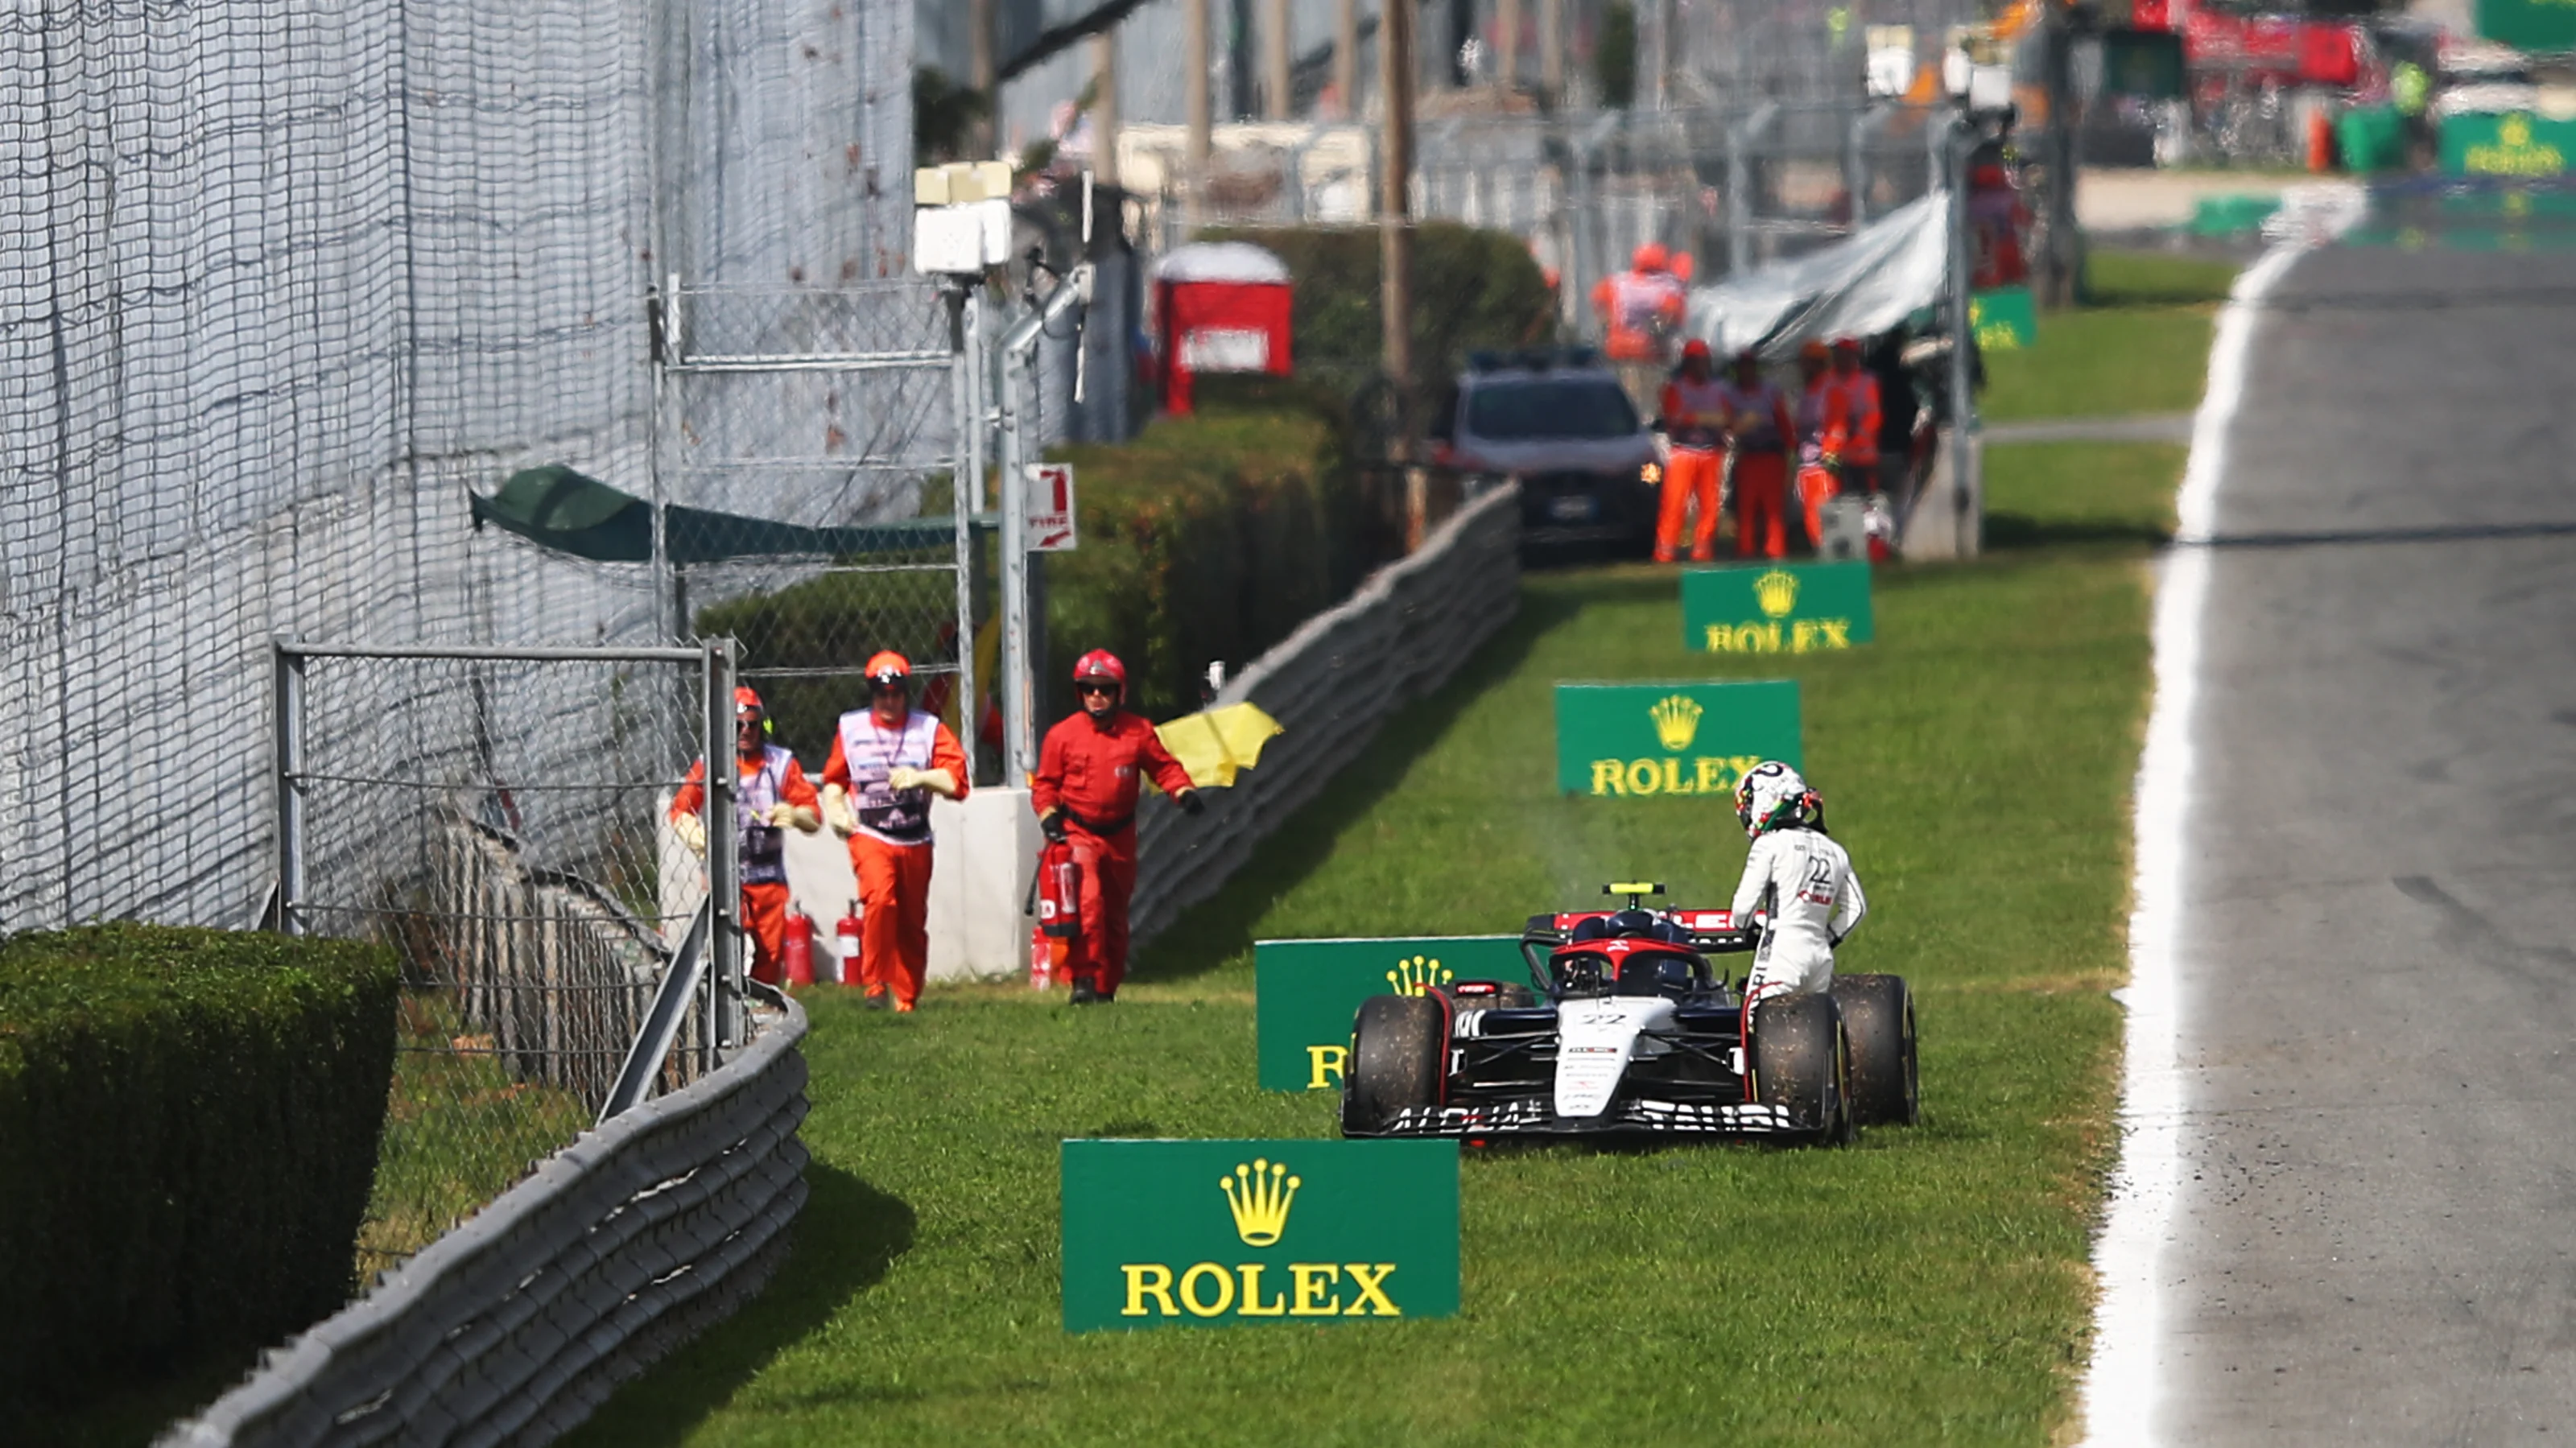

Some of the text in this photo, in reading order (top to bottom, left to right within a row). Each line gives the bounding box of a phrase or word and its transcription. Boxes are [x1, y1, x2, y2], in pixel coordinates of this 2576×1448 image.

[1704, 618, 1850, 654] ROLEX
[1591, 756, 1761, 796] ROLEX
[1808, 856, 1831, 885] 22
[1121, 1261, 1401, 1318] ROLEX
